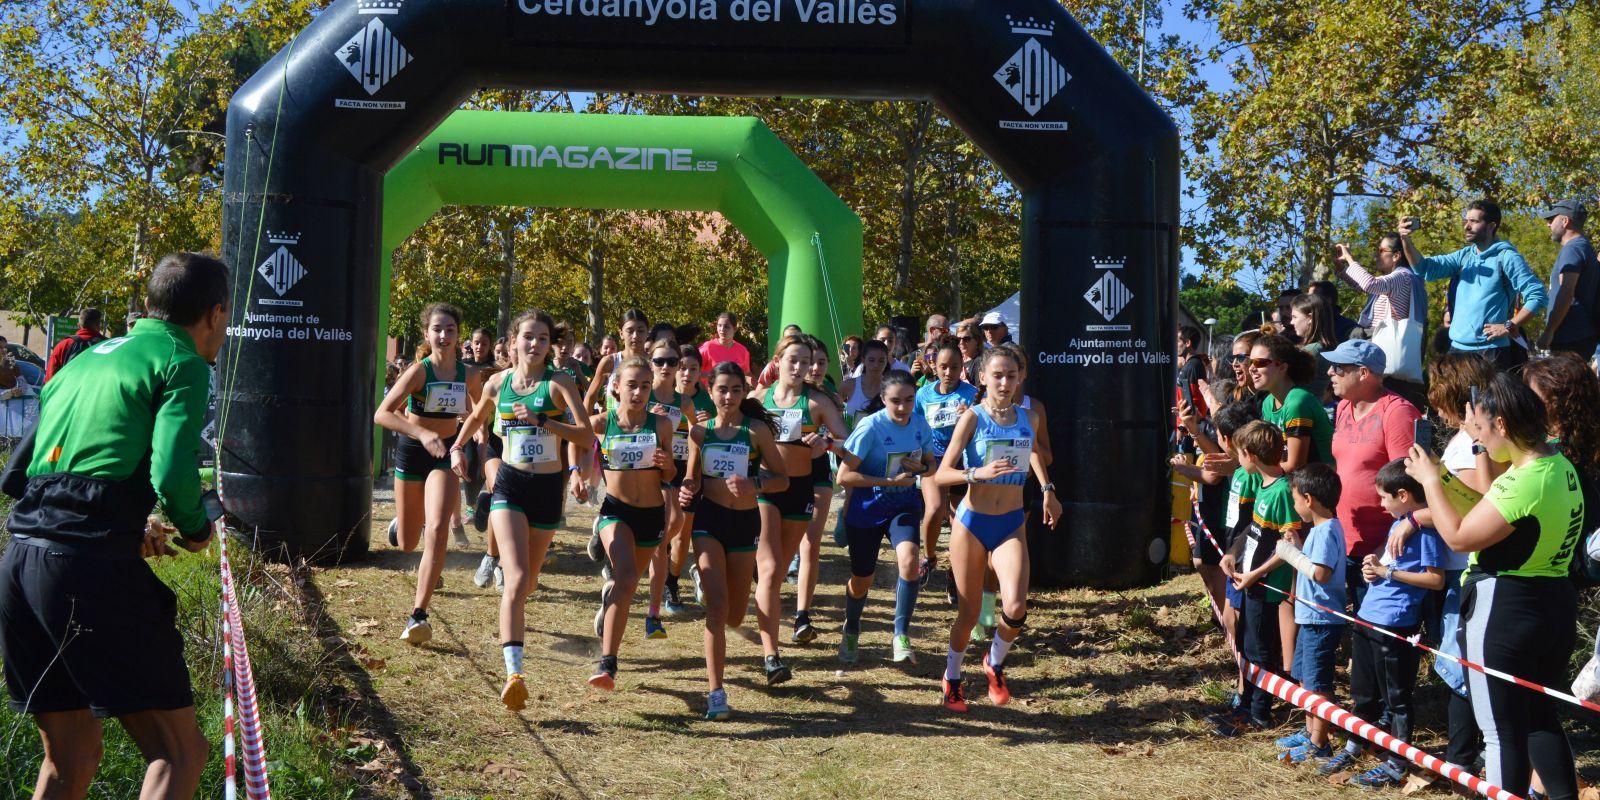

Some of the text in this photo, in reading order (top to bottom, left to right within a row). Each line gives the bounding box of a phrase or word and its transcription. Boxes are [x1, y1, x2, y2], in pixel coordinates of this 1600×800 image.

[518, 0, 897, 26] Cerdanyola del Vallès
[244, 311, 320, 324] Ajuntament de
[226, 325, 353, 341] erdanyola del Vallès
[1069, 338, 1147, 350] Ajuntament de
[1038, 351, 1171, 367] Cerdanyola del Vallès
[437, 397, 457, 408] 213
[521, 444, 544, 456] 180
[621, 451, 643, 463] 209
[713, 459, 735, 472] 225
